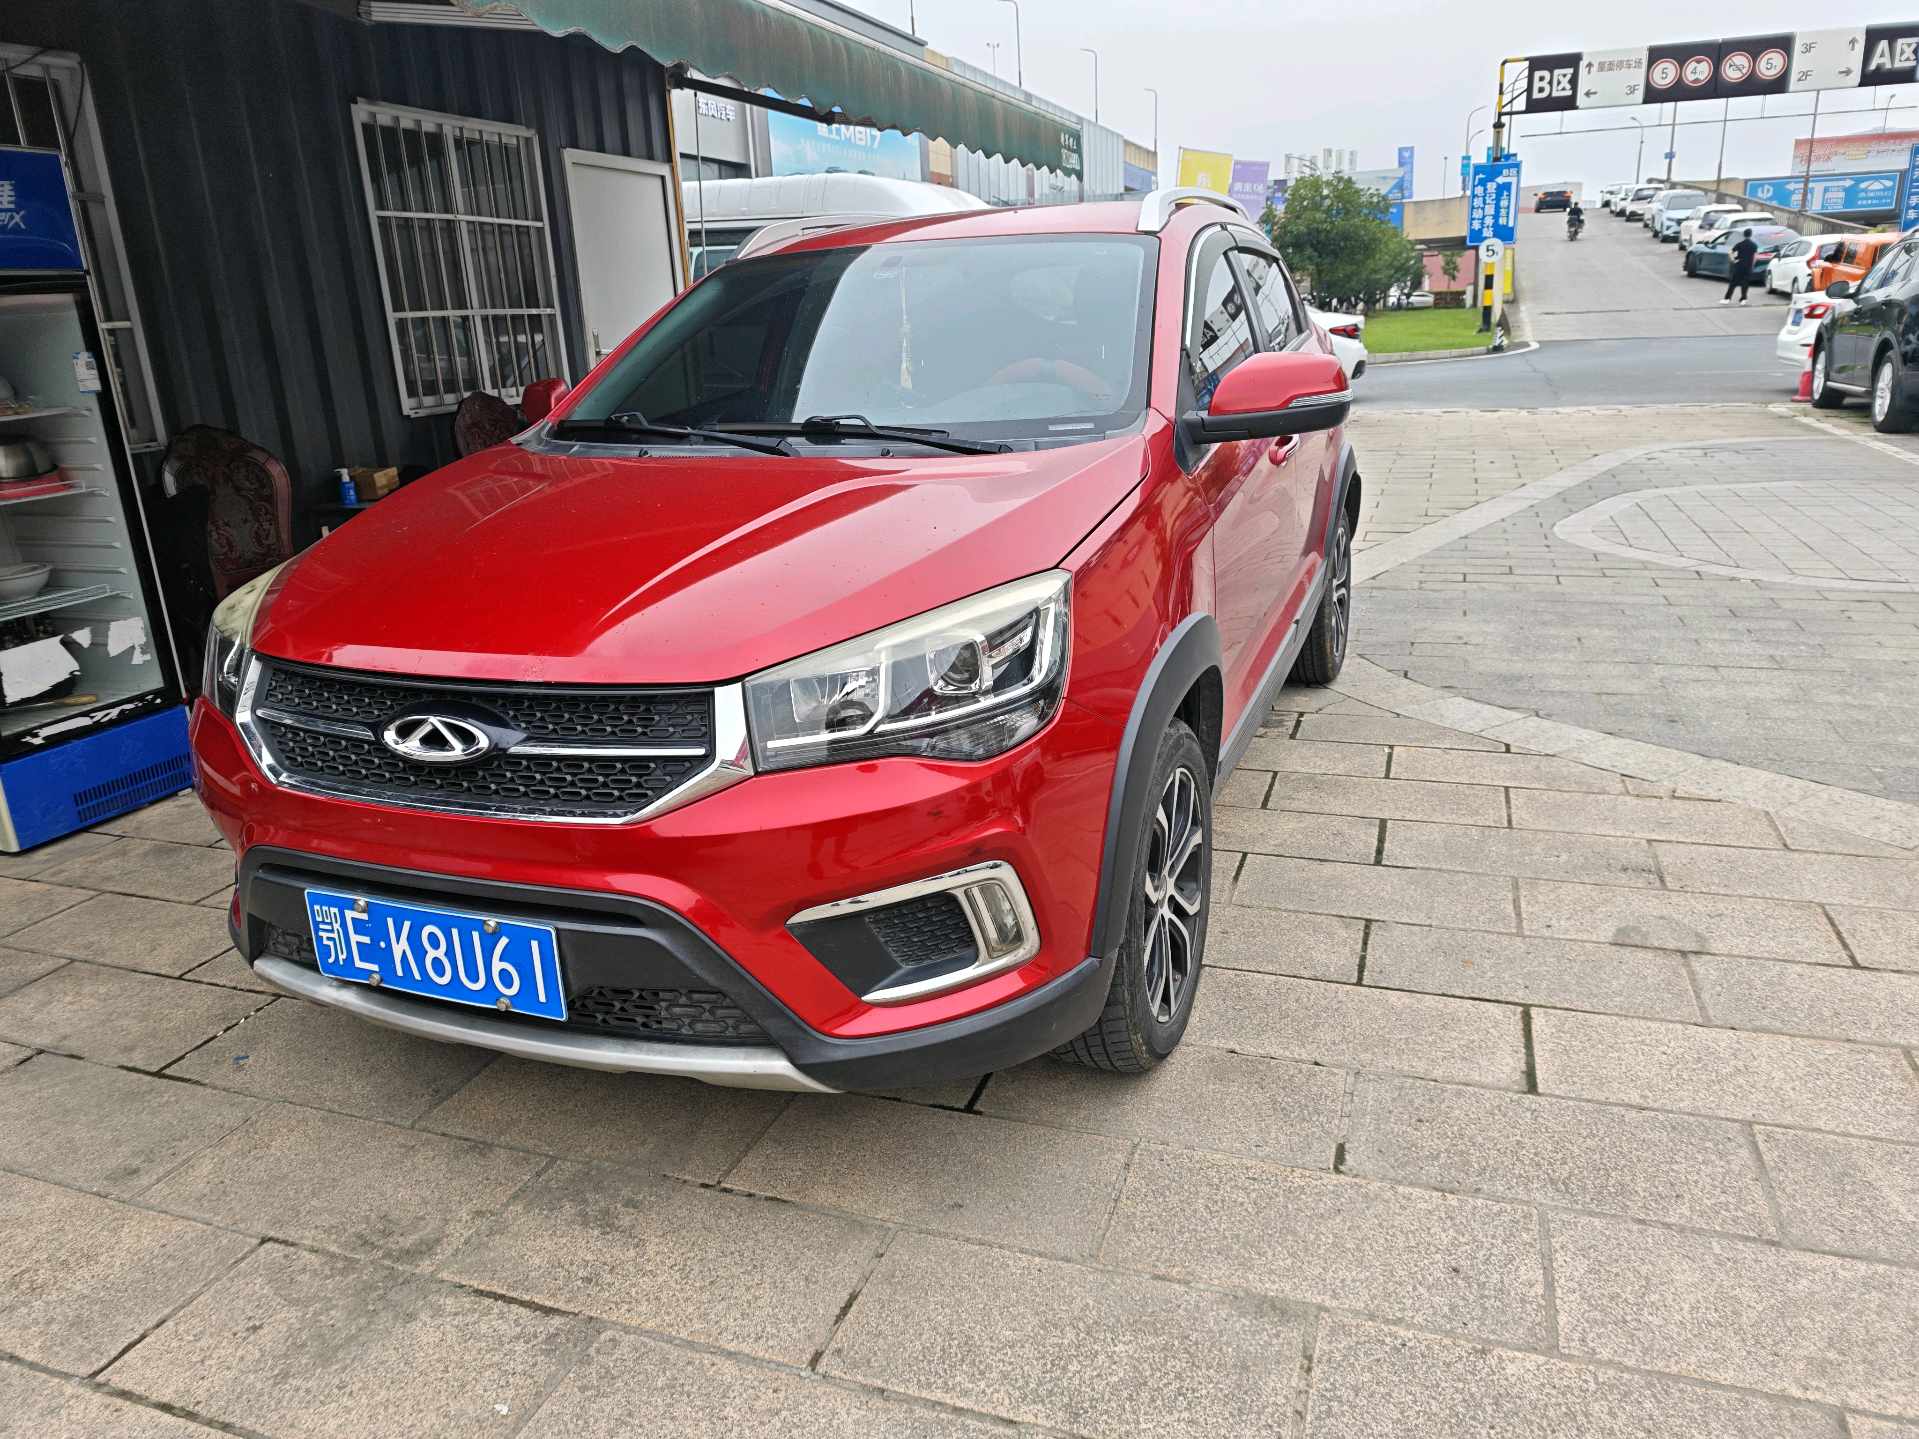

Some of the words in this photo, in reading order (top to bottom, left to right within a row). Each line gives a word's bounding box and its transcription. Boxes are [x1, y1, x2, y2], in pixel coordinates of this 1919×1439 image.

[1801, 42, 1816, 54] 3F
[1867, 36, 1919, 70] A区
[1661, 67, 1669, 81] 5
[1797, 70, 1813, 82] 2F
[1532, 68, 1574, 99] B区
[1625, 84, 1640, 96] 3F
[698, 97, 736, 121] 东风汽车
